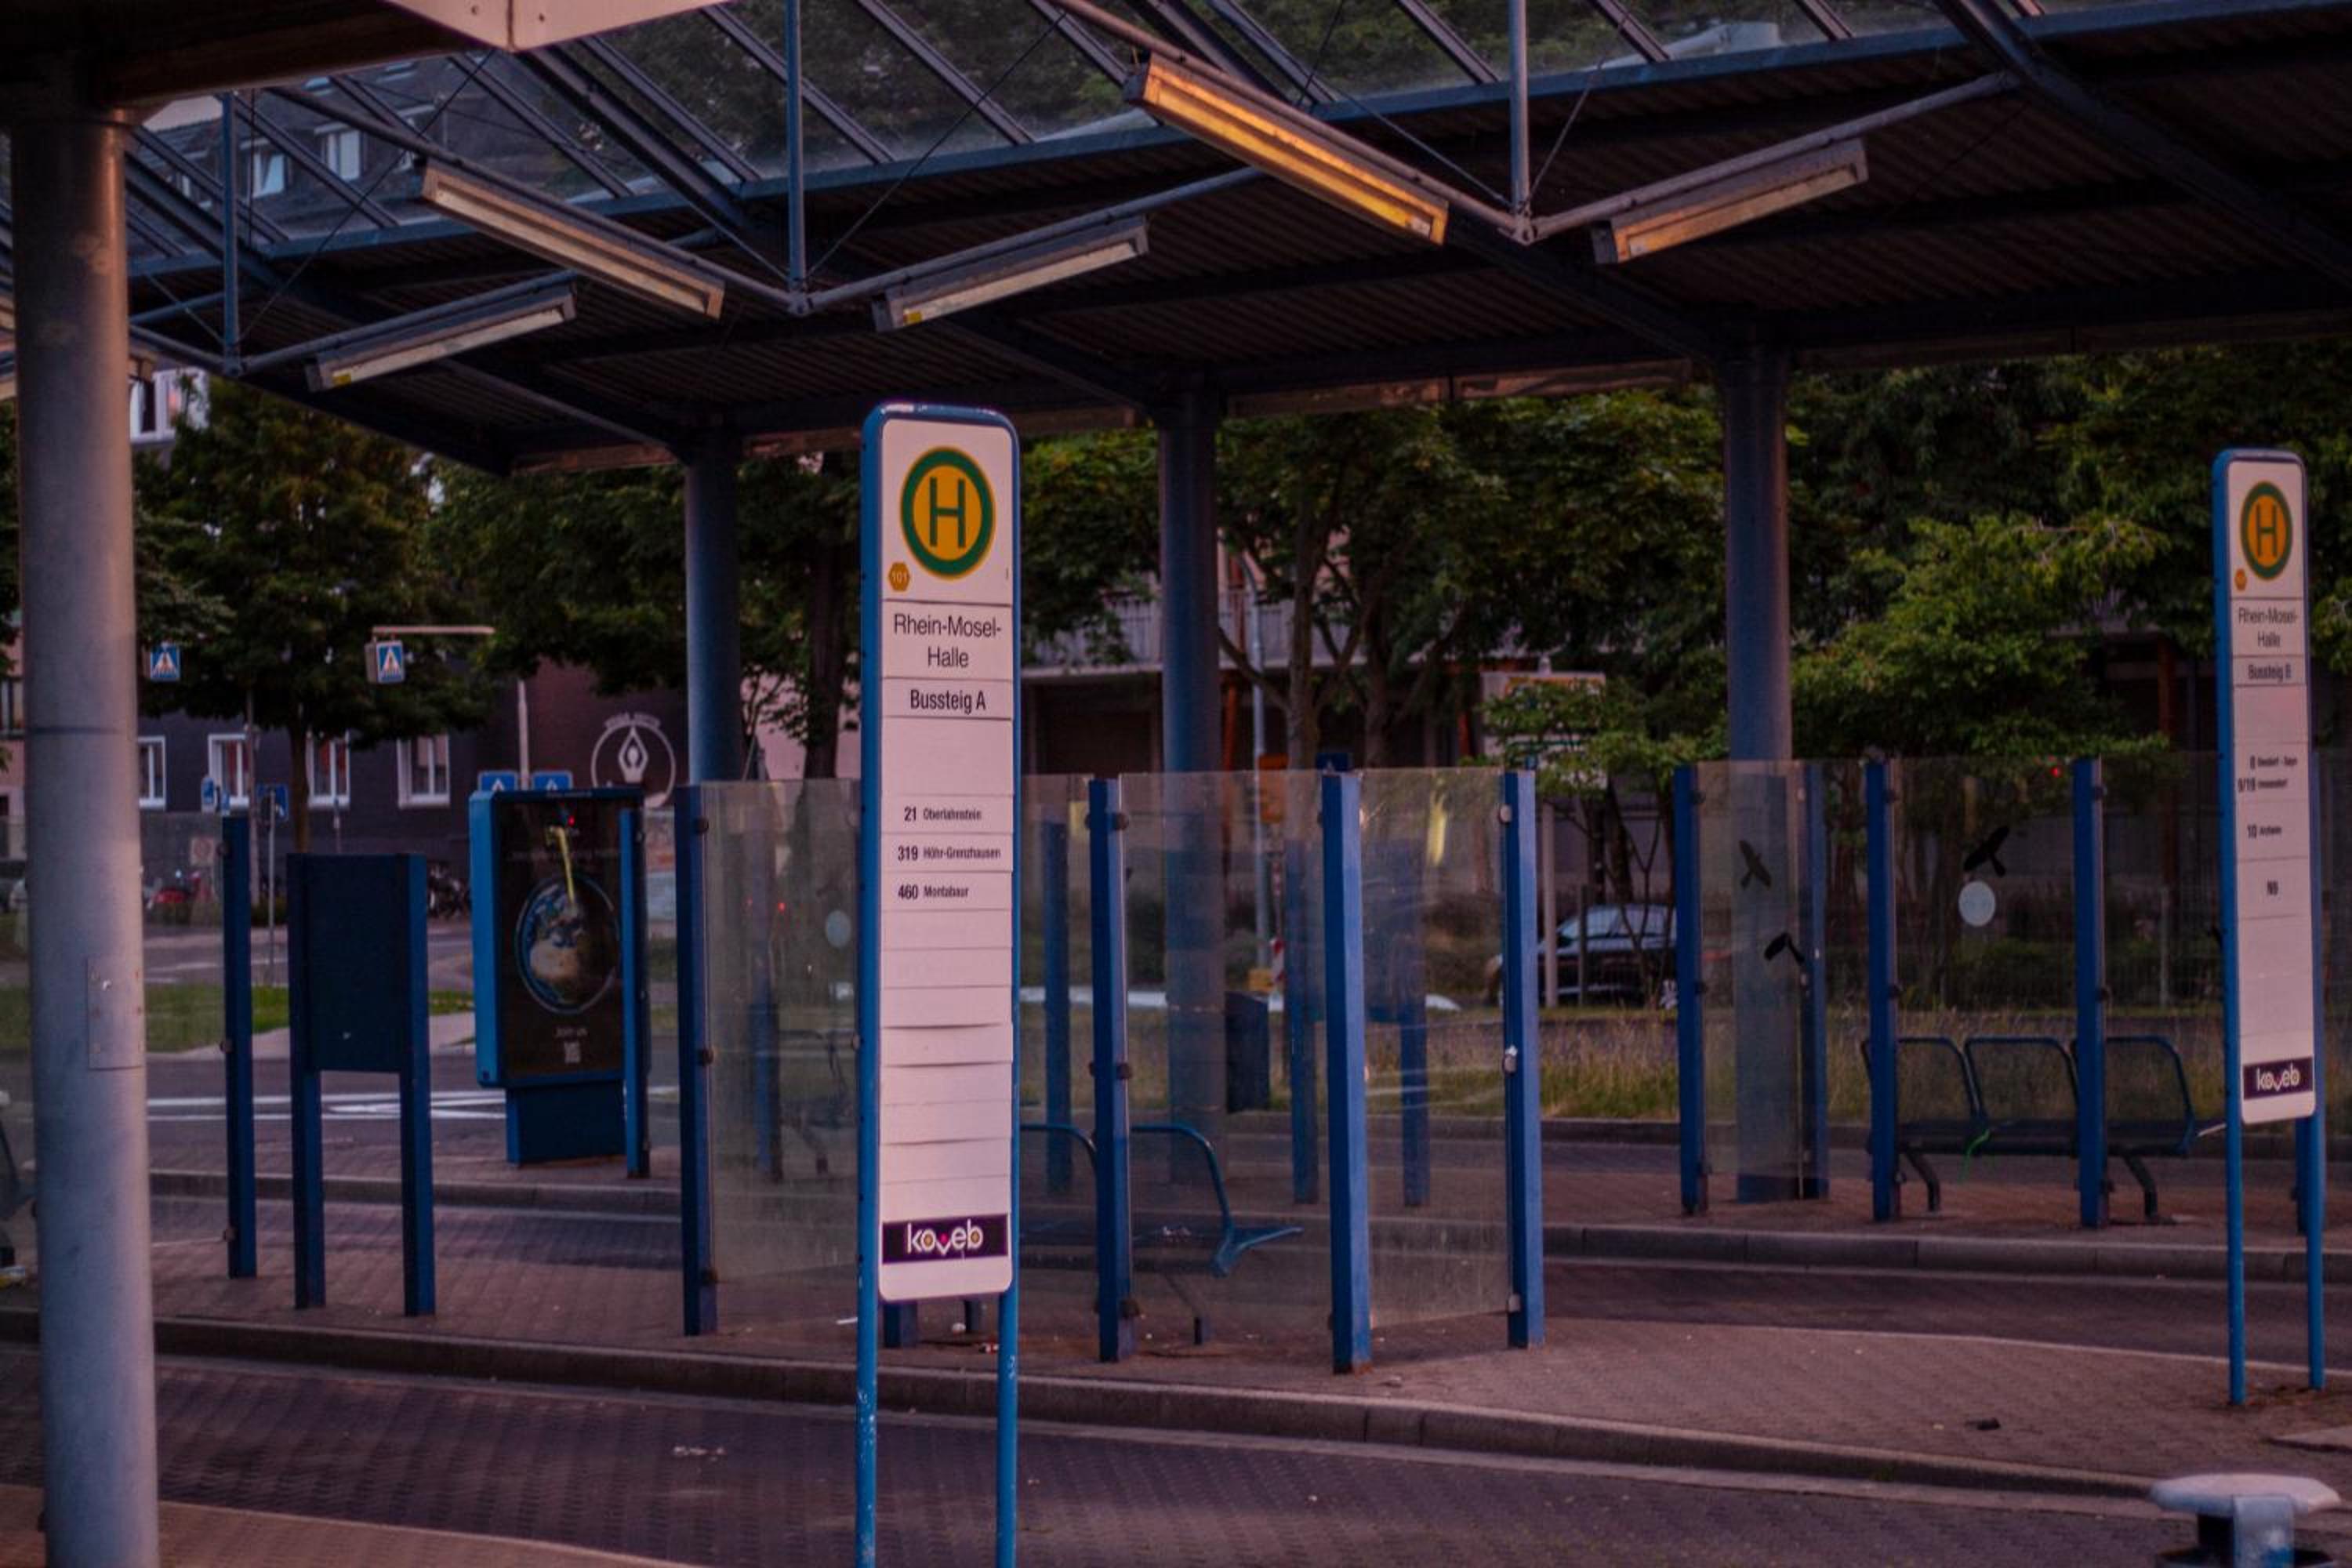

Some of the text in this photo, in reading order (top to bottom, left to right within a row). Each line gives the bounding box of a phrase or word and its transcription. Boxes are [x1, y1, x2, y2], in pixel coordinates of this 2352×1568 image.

[894, 613, 1002, 637] Rhein-Mosel-
[927, 646, 969, 668] Halle
[910, 689, 986, 714] Bussteig A
[904, 806, 982, 822] 21 Oberlahnstein
[898, 845, 919, 862] 319
[898, 884, 970, 900] 460 Montabaur
[906, 1218, 984, 1257] koveb
